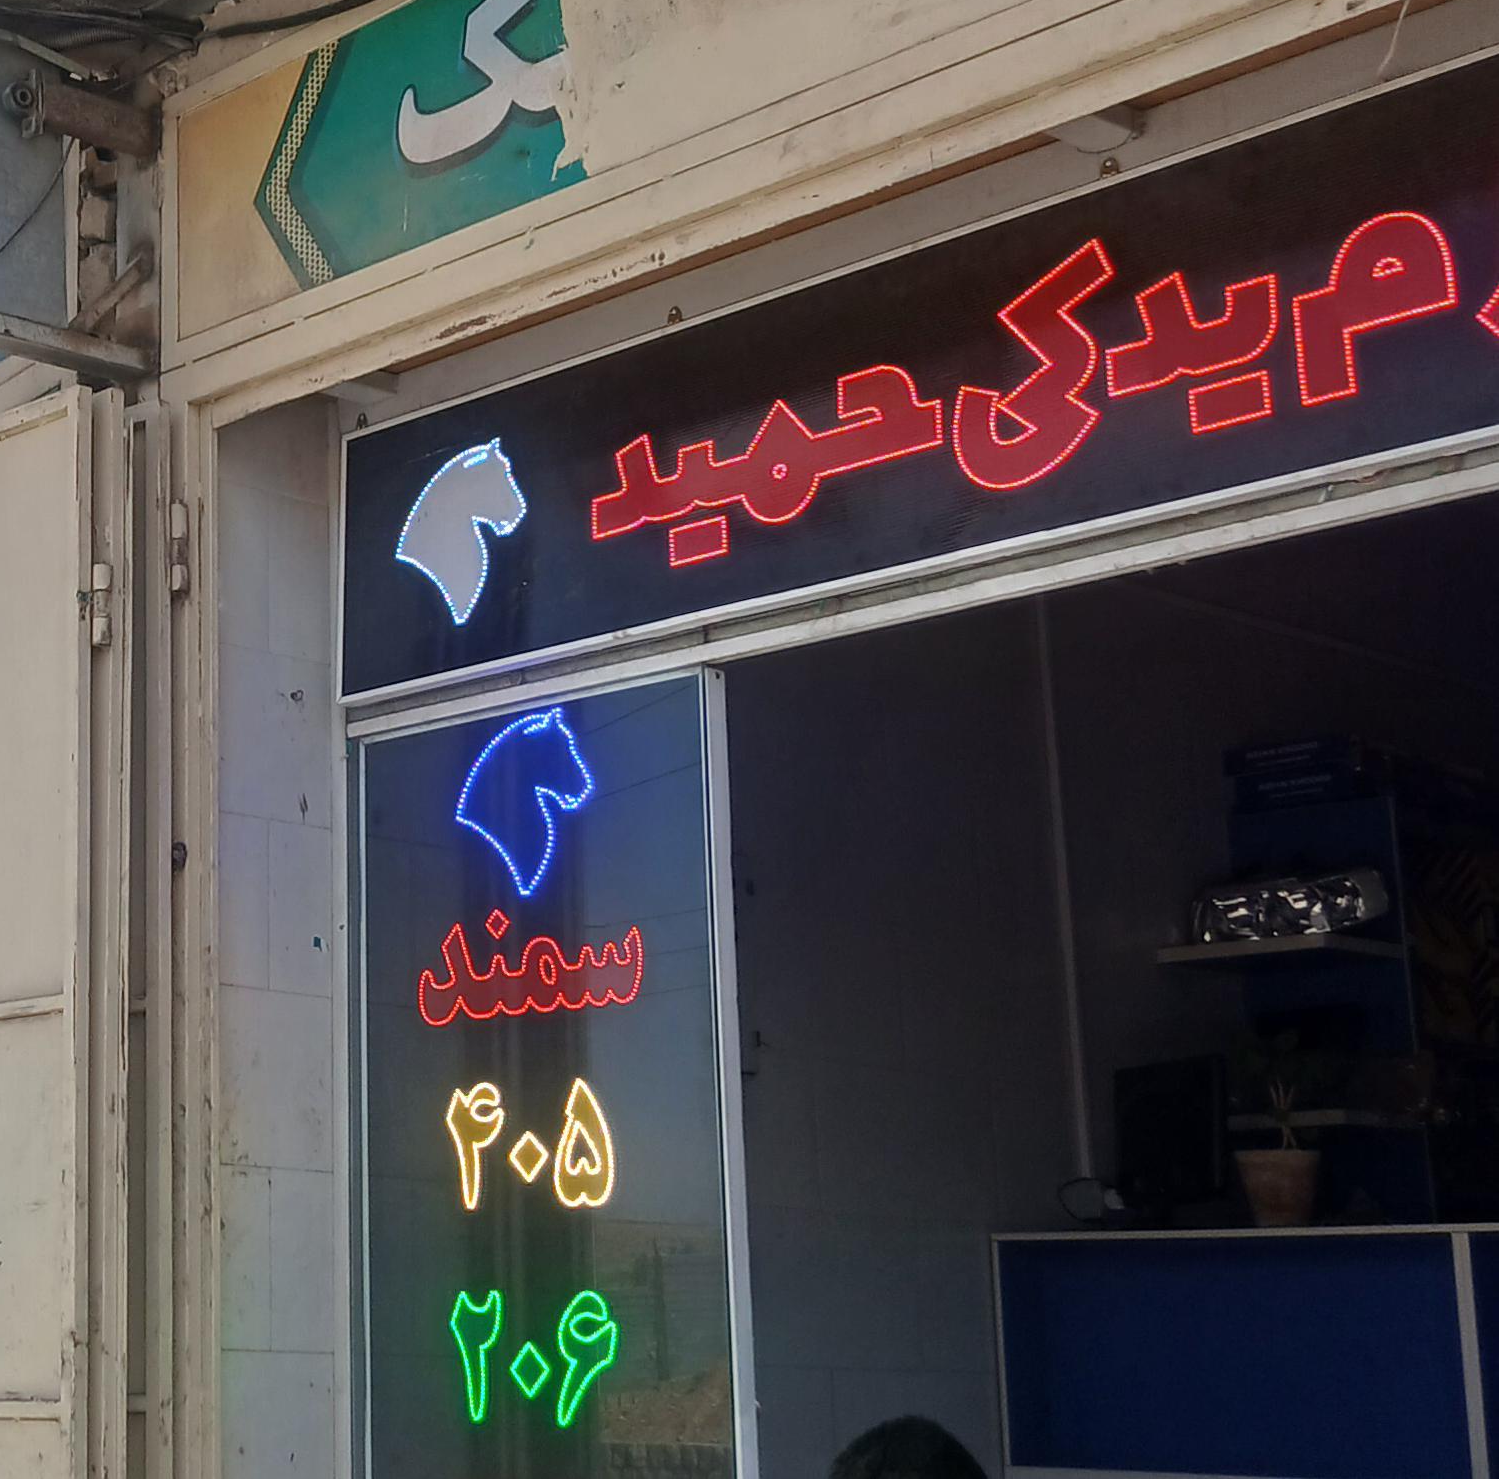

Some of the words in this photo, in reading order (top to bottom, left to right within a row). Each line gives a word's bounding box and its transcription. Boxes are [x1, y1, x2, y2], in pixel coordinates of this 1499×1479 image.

[952, 238, 1279, 490] یدکی
[591, 364, 944, 569] حمید
[417, 908, 644, 1026] سمند
[446, 1077, 615, 1211] ۴۰۵
[450, 1290, 621, 1427] ۲۰۶
